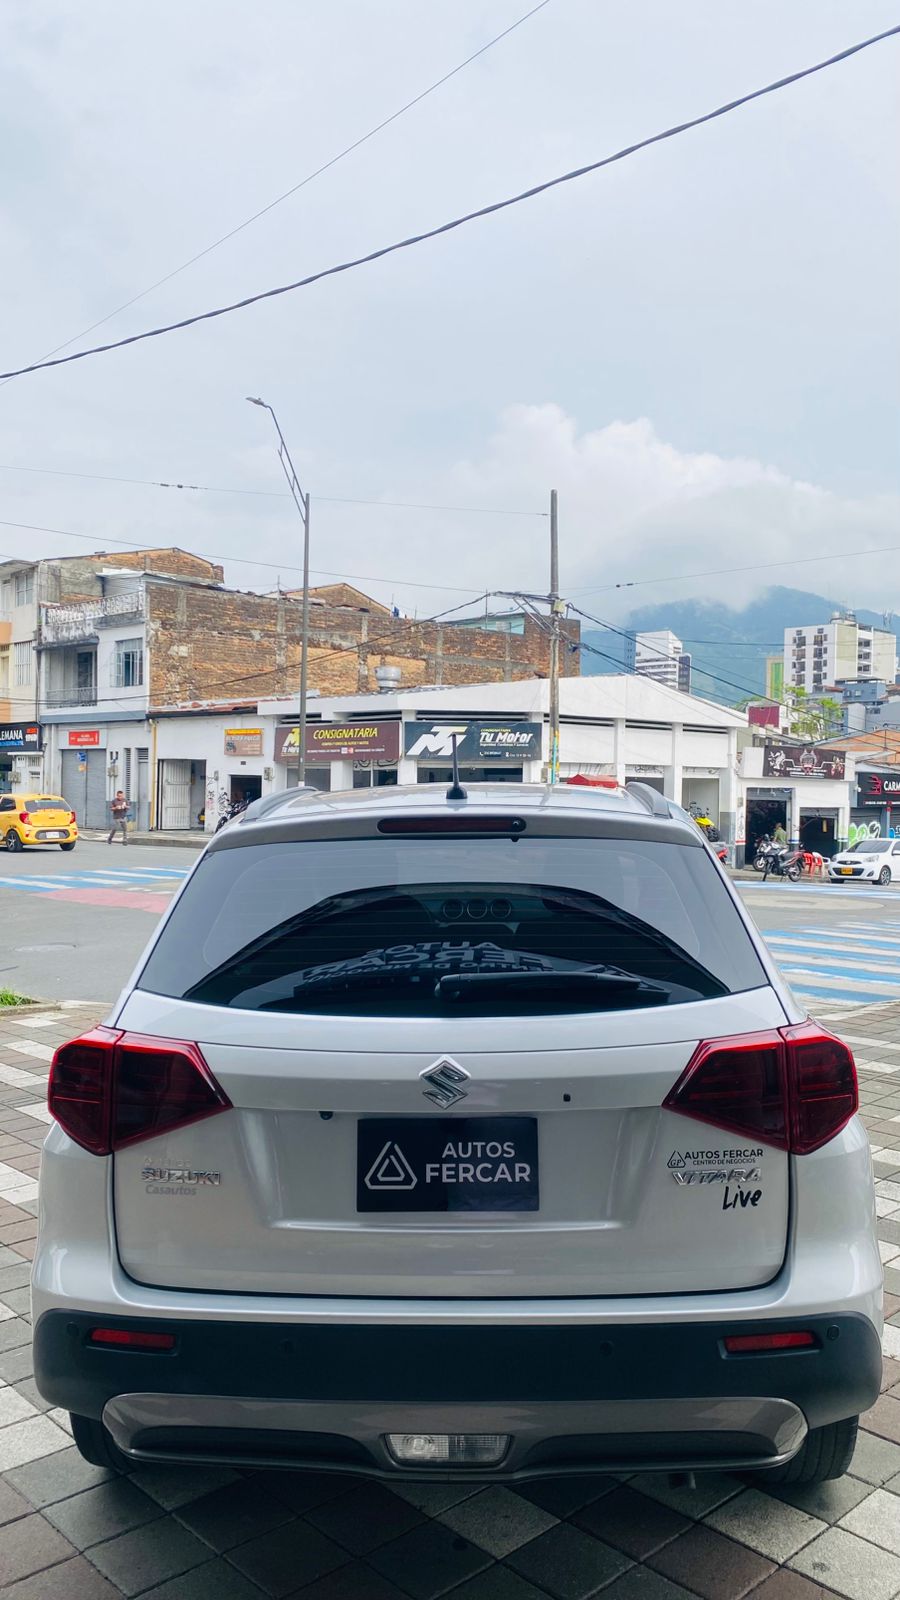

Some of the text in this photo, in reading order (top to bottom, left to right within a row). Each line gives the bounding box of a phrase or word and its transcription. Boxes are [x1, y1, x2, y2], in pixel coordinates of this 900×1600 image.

[313, 727, 378, 740] CONSIGNATARIA
[496, 731, 534, 743] Motor
[442, 1141, 515, 1158] AUTOS
[684, 1148, 764, 1160] AUTOS FERCAR
[141, 1167, 221, 1185] SUZUKI
[425, 1163, 531, 1183] FERCAR
[672, 1167, 761, 1186] VITARA
[145, 1184, 197, 1196] Casautos
[722, 1184, 762, 1210] Live
